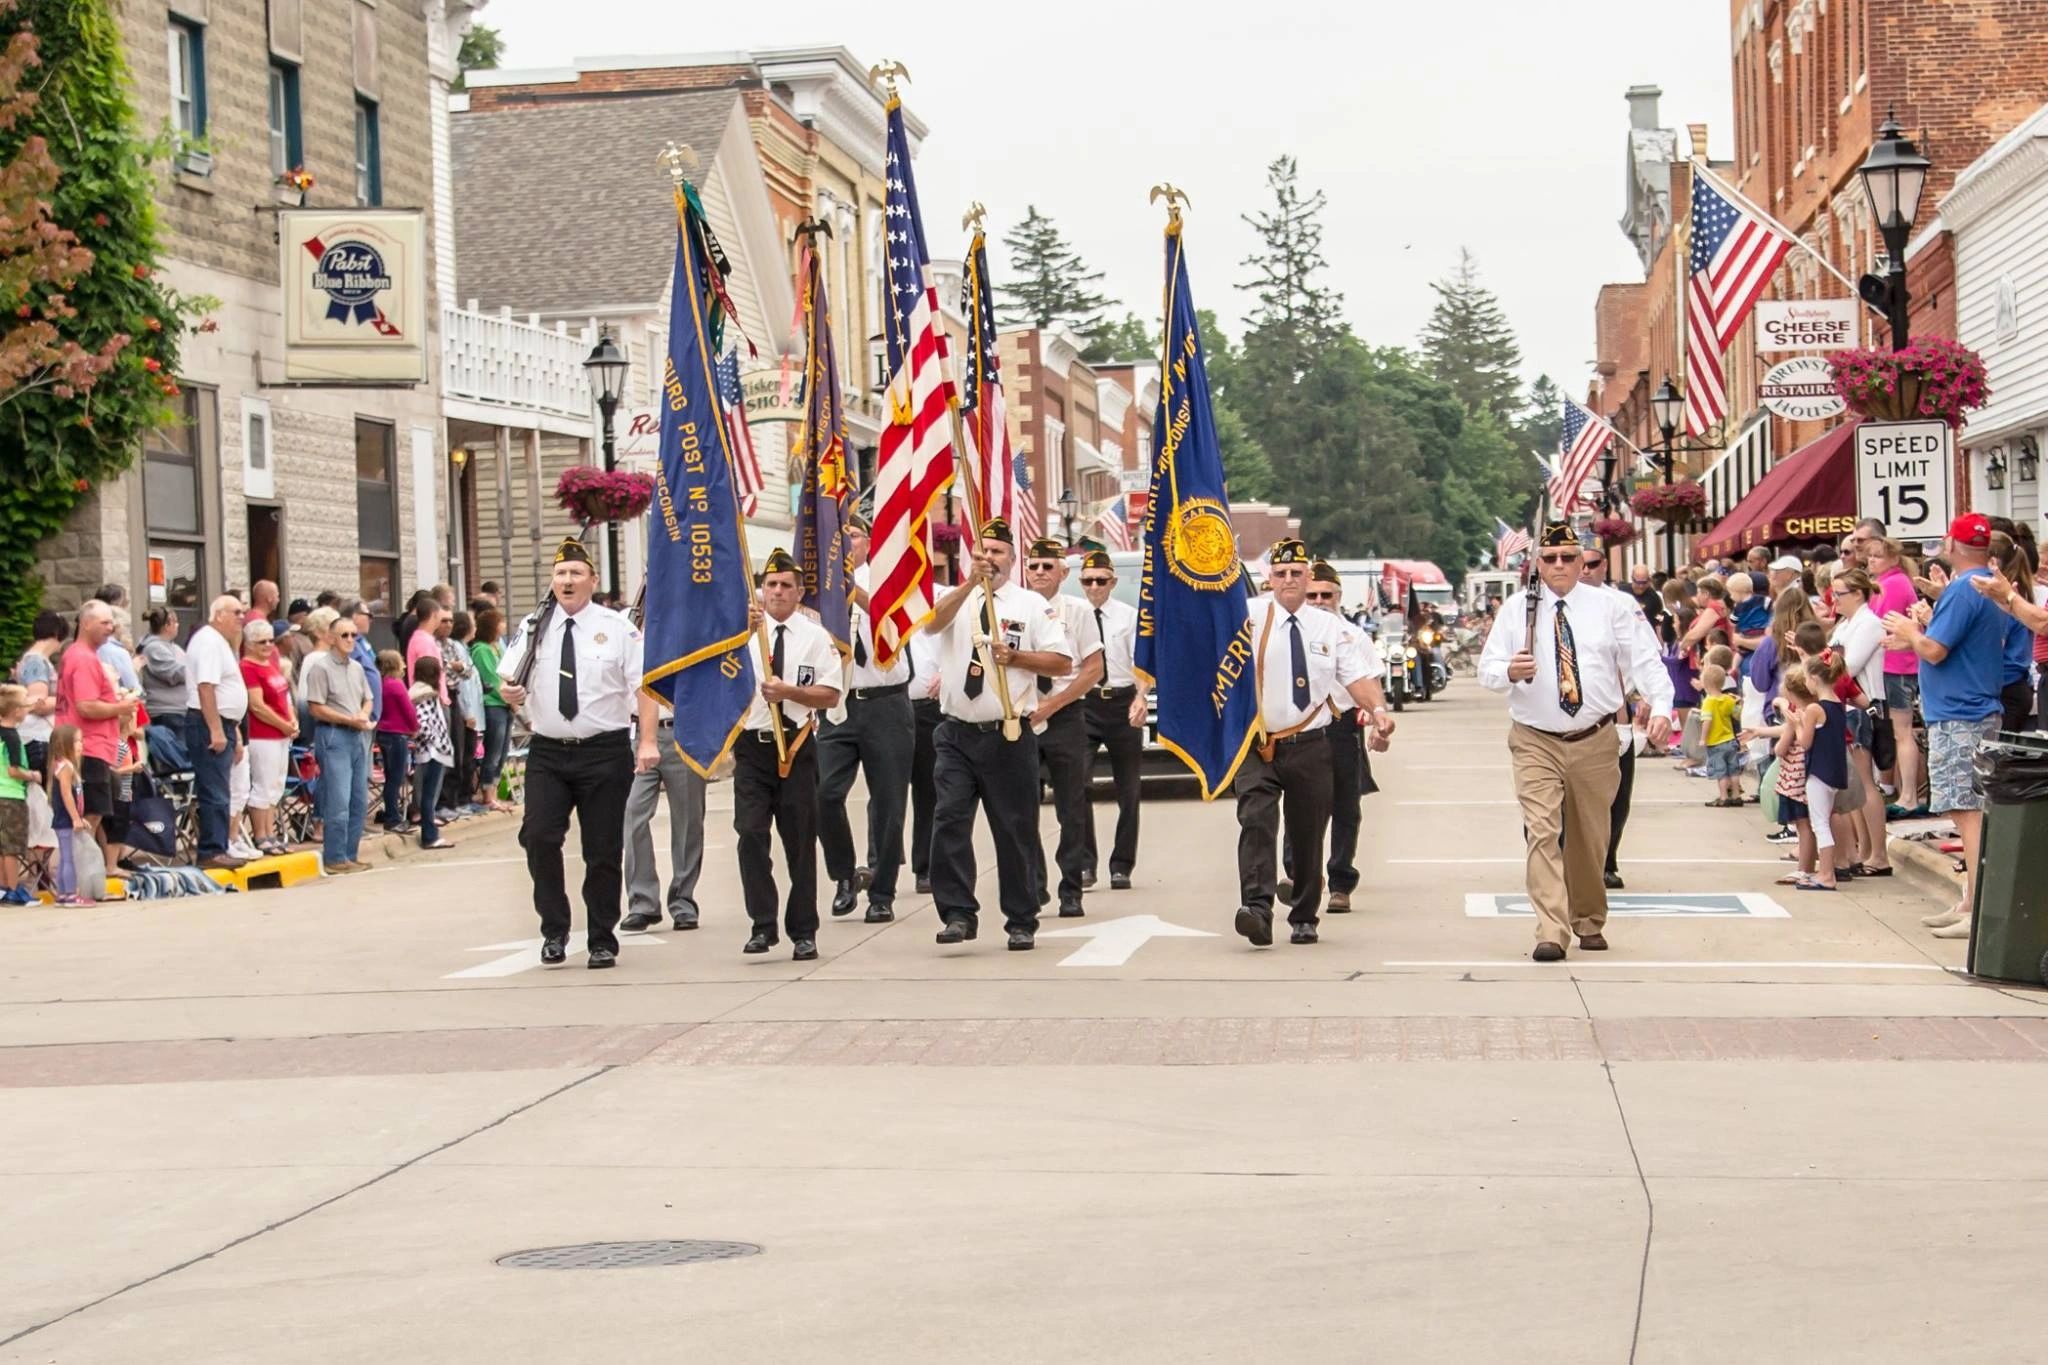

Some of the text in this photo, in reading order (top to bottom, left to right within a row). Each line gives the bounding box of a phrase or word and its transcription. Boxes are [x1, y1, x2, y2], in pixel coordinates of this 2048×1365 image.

[328, 248, 373, 271] Pabst
[314, 272, 390, 289] Blue Ribbon
[1764, 320, 1851, 333] CHEESE
[1774, 332, 1845, 346] STORE
[1767, 360, 1829, 385] BREWST
[1761, 384, 1836, 396] RESTAURA
[745, 394, 804, 412] SHOS
[678, 422, 704, 474] POST
[1865, 435, 1939, 456] SPEED
[1874, 459, 1931, 479] LIMIT
[1878, 484, 1930, 526] 15
[1785, 516, 1858, 535] CHEES
[690, 523, 712, 583] 10533
[803, 527, 818, 596] JOSEPH
[720, 651, 743, 679] OF
